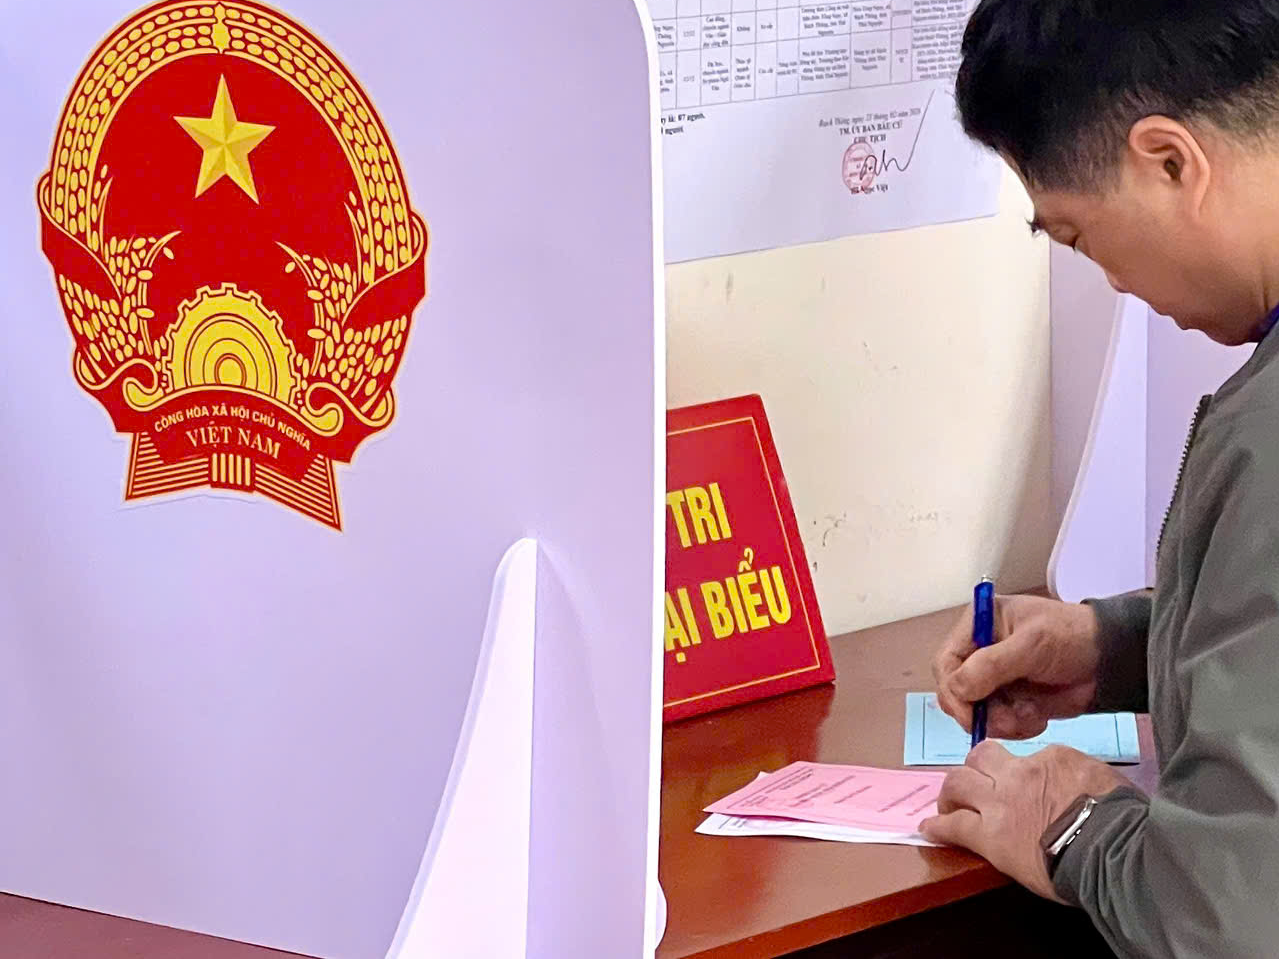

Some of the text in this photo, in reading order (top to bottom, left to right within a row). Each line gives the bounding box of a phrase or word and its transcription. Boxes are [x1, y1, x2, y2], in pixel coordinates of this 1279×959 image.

[185, 420, 281, 459] VIỆT NAM
[186, 404, 209, 419] HÒA
[212, 402, 228, 416] XÃ
[230, 406, 250, 422] HỘI
[252, 410, 276, 428] CHỦ
[277, 421, 311, 451] NGHĨA
[666, 482, 733, 548] TRI
[700, 547, 792, 639] BIỂU
